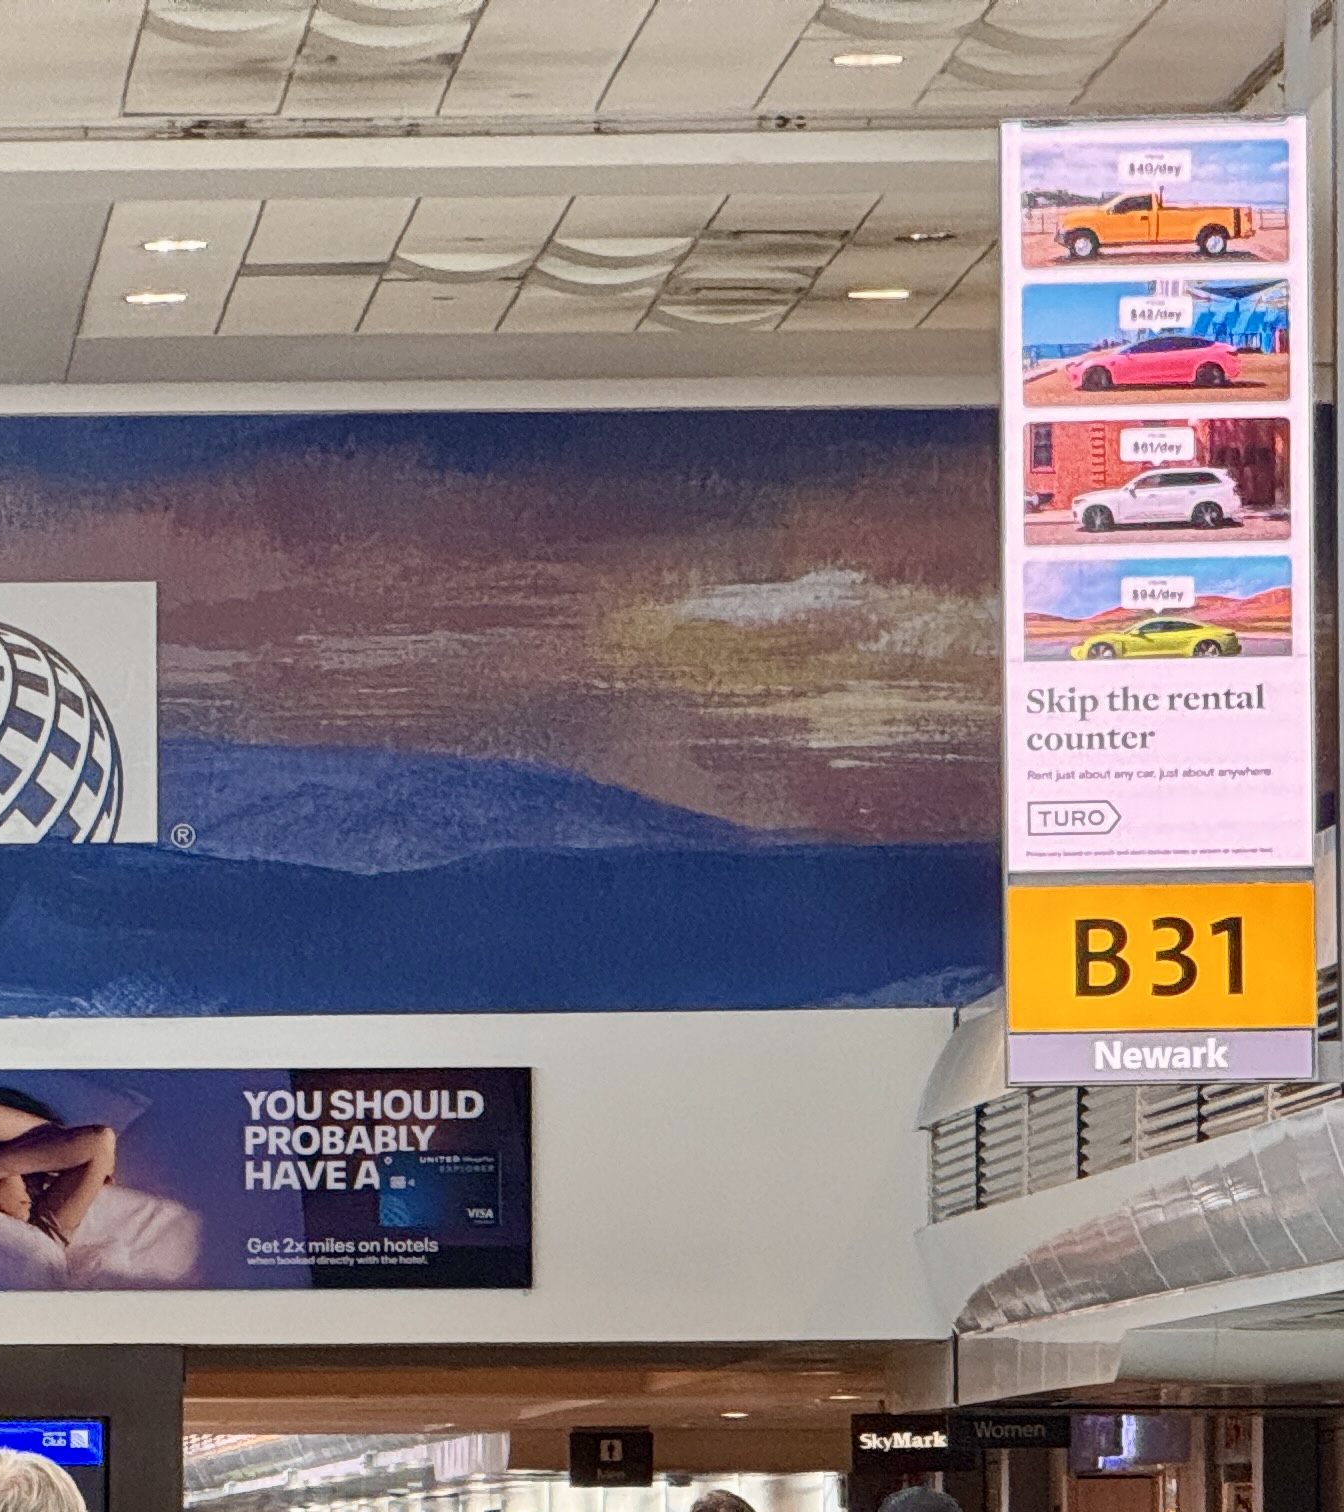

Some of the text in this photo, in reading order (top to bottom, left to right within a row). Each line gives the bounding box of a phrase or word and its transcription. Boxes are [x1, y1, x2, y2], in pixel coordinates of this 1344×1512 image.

[1026, 683, 1265, 721] Skip the rental
[1026, 728, 1156, 752] counter
[1027, 770, 1052, 780] Rent
[1055, 770, 1075, 782] just
[1079, 770, 1110, 780] about
[1114, 771, 1134, 781] any
[1159, 768, 1179, 781] just
[1182, 768, 1214, 778] about
[1038, 809, 1105, 827] TURO
[1075, 916, 1244, 997] B31
[1093, 1037, 1229, 1071] Newark
[242, 1089, 486, 1121] YOU SHOULD
[244, 1125, 436, 1156] PROBABLY
[245, 1160, 381, 1191] HAVE A
[466, 1207, 495, 1219] VISA
[247, 1237, 439, 1253] Get 2x miles on hotels
[859, 1431, 948, 1452] SkyMark
[973, 1420, 1047, 1439] Women
